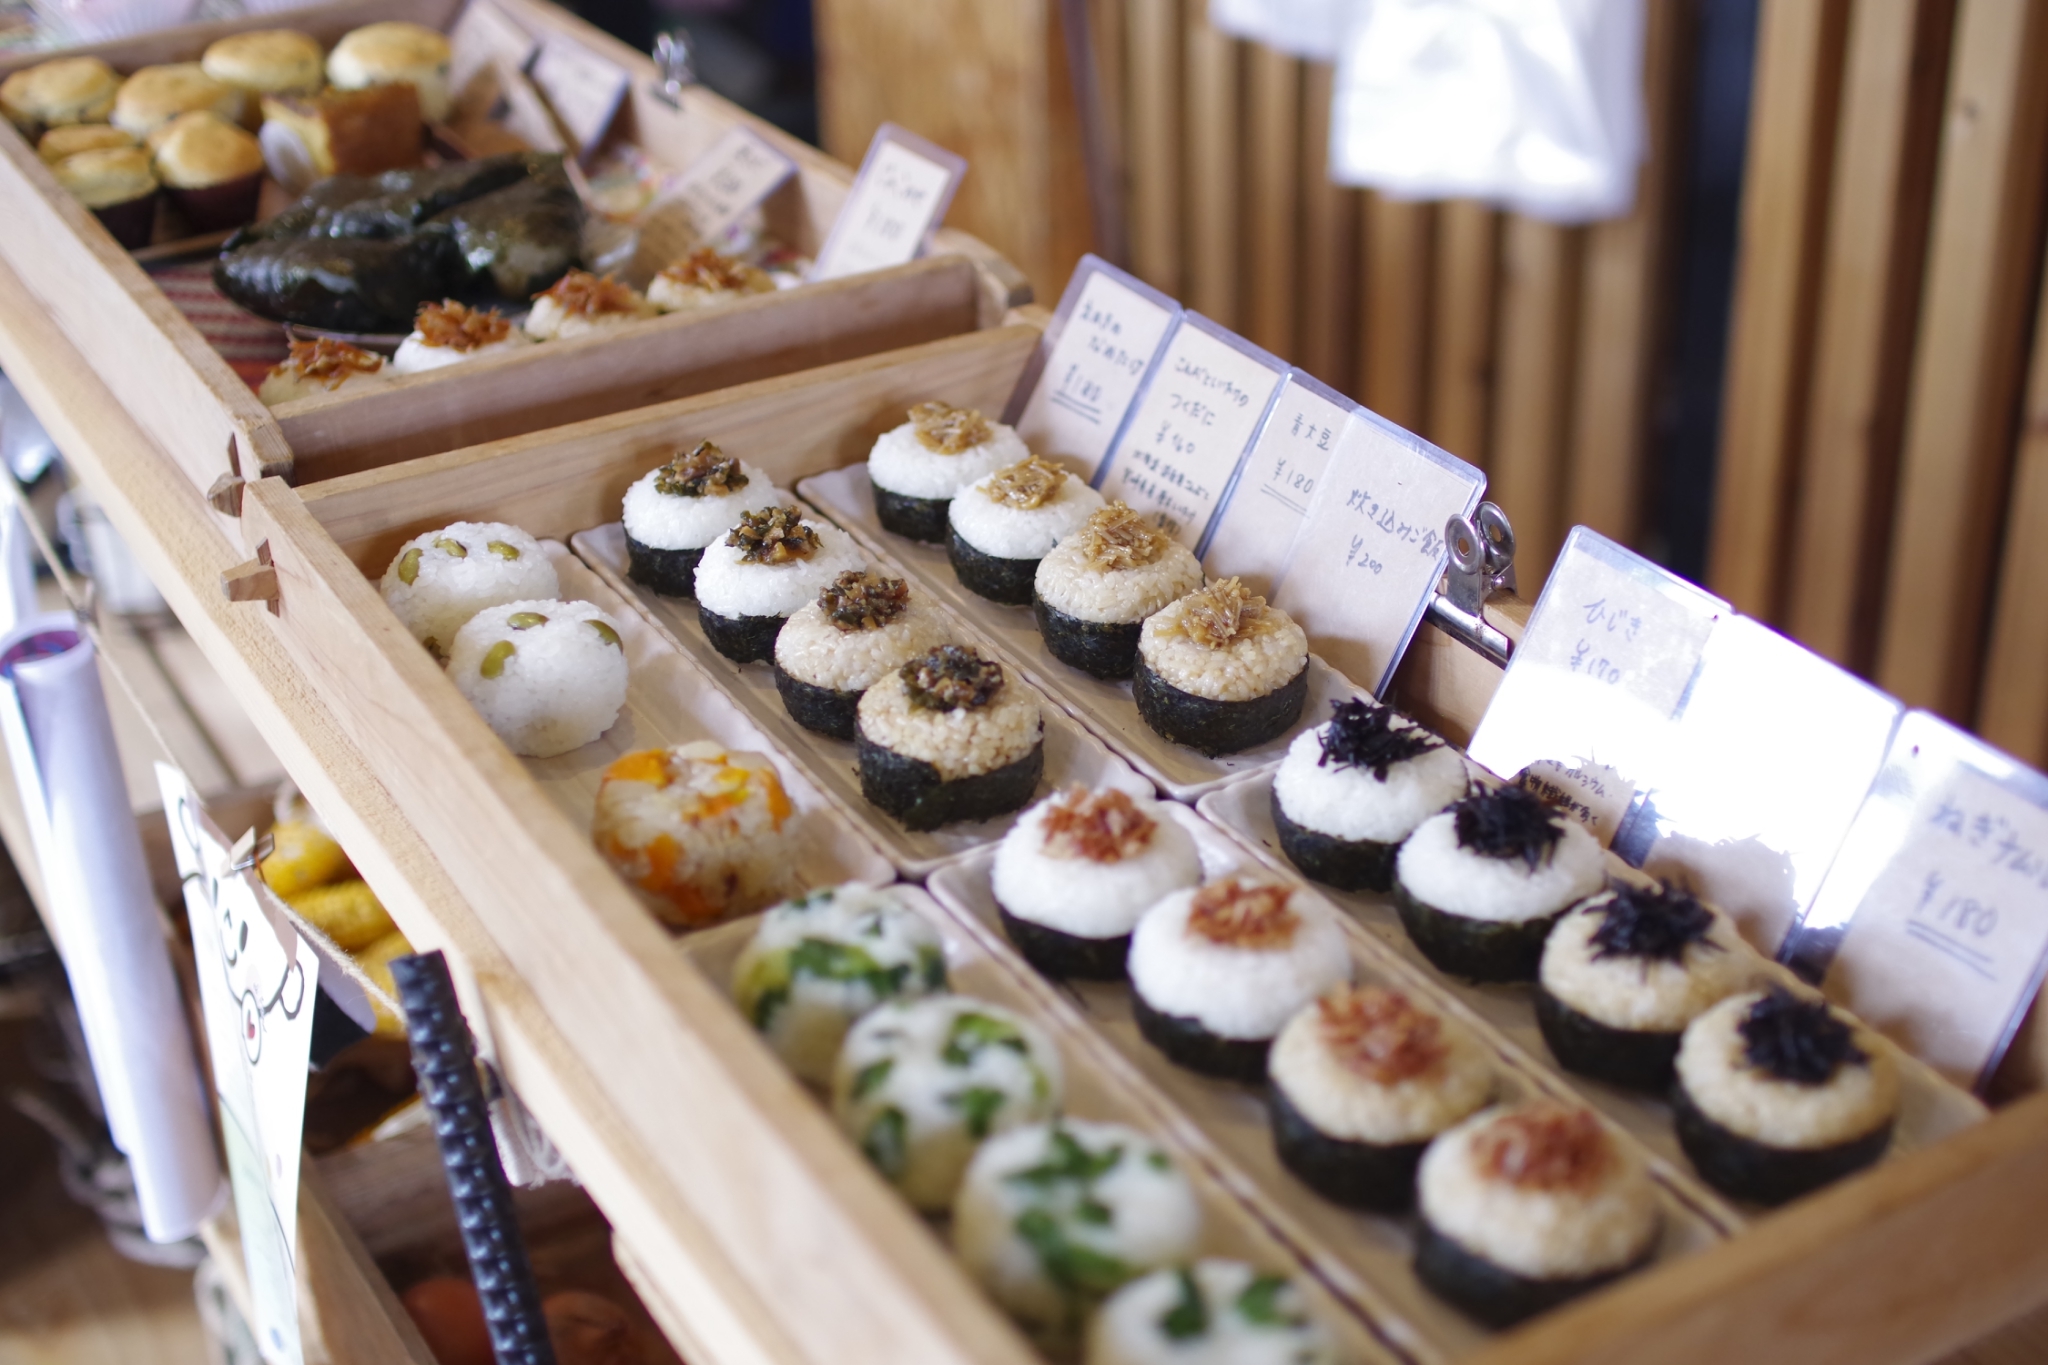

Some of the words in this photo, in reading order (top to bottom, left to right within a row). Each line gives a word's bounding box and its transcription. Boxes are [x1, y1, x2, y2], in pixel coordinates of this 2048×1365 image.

[1170, 393, 1215, 426] つくだに
[1291, 413, 1331, 451] 青大豆
[1273, 457, 1314, 494] ¥180
[1346, 489, 1444, 560] 炊き込みご飯
[1346, 534, 1383, 574] ¥200
[1583, 598, 1642, 642] ひじき
[1570, 638, 1620, 685] ¥170
